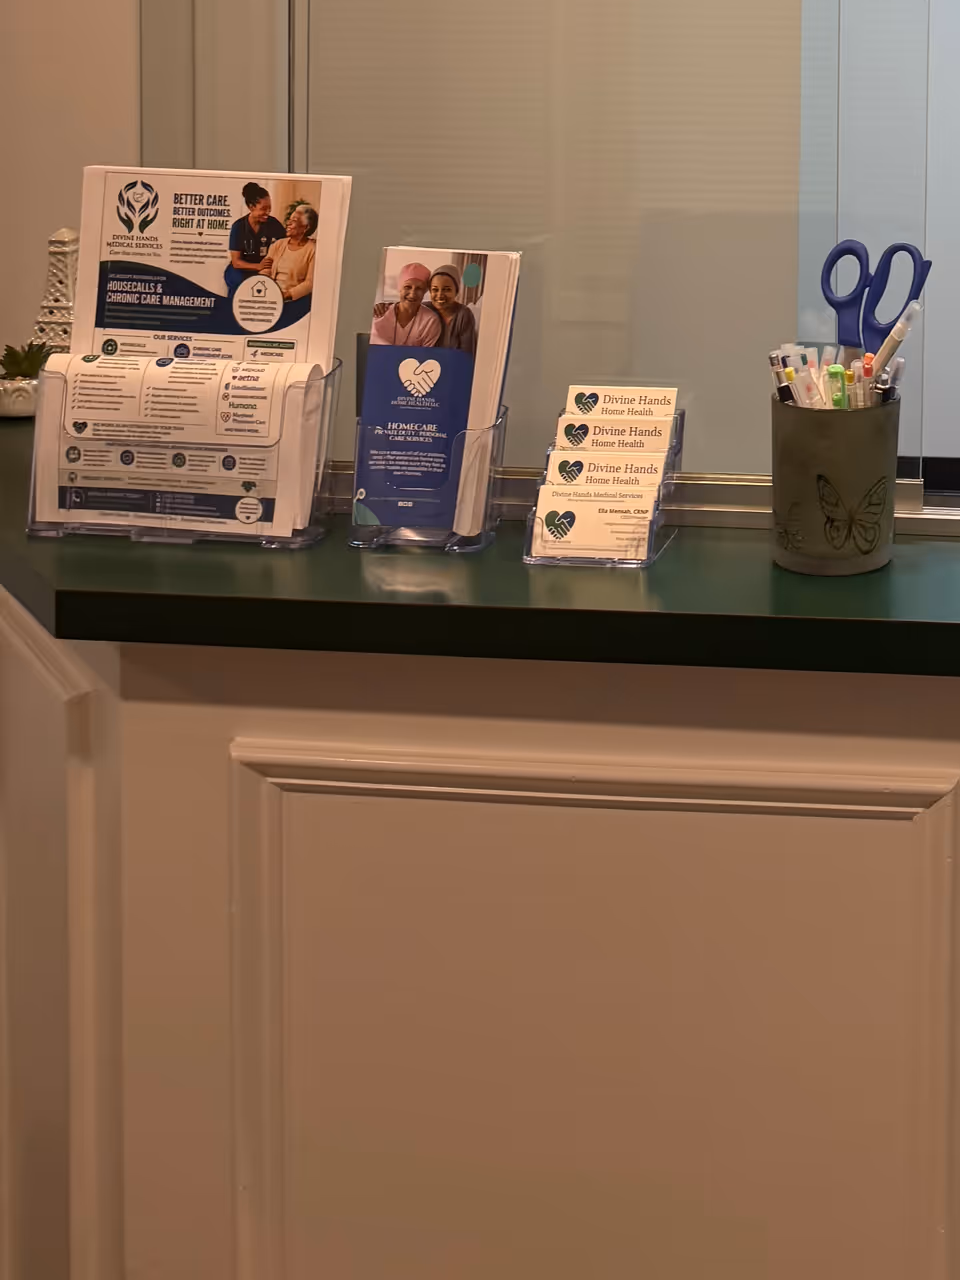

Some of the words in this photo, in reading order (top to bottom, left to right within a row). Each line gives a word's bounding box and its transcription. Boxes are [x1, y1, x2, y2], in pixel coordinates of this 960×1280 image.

[173, 193, 204, 206] BETTER
[206, 194, 230, 207] CARE.
[172, 206, 196, 216] BETTER
[197, 207, 232, 218] OUTCOMES.
[172, 218, 195, 228] RIGHT
[196, 218, 206, 229] AT
[207, 219, 231, 230] HOME.
[107, 280, 155, 293] HOUSECALLS
[155, 283, 163, 293] &
[106, 293, 139, 304] CHRONIC
[140, 294, 161, 305] CARE
[162, 295, 216, 308] MANAGEMENT
[228, 401, 257, 410] Humana
[602, 394, 636, 405] Divine
[638, 395, 672, 406] Hands
[600, 407, 625, 416] Home
[626, 407, 654, 416] Health
[387, 422, 438, 432] HOMECARE
[592, 425, 626, 436] Divine
[628, 426, 663, 437] Hands
[591, 439, 616, 447] Home
[617, 439, 645, 448] Health
[587, 462, 621, 473] Divine
[624, 463, 659, 474] Hands
[585, 476, 610, 484] Home
[612, 476, 640, 485] Health
